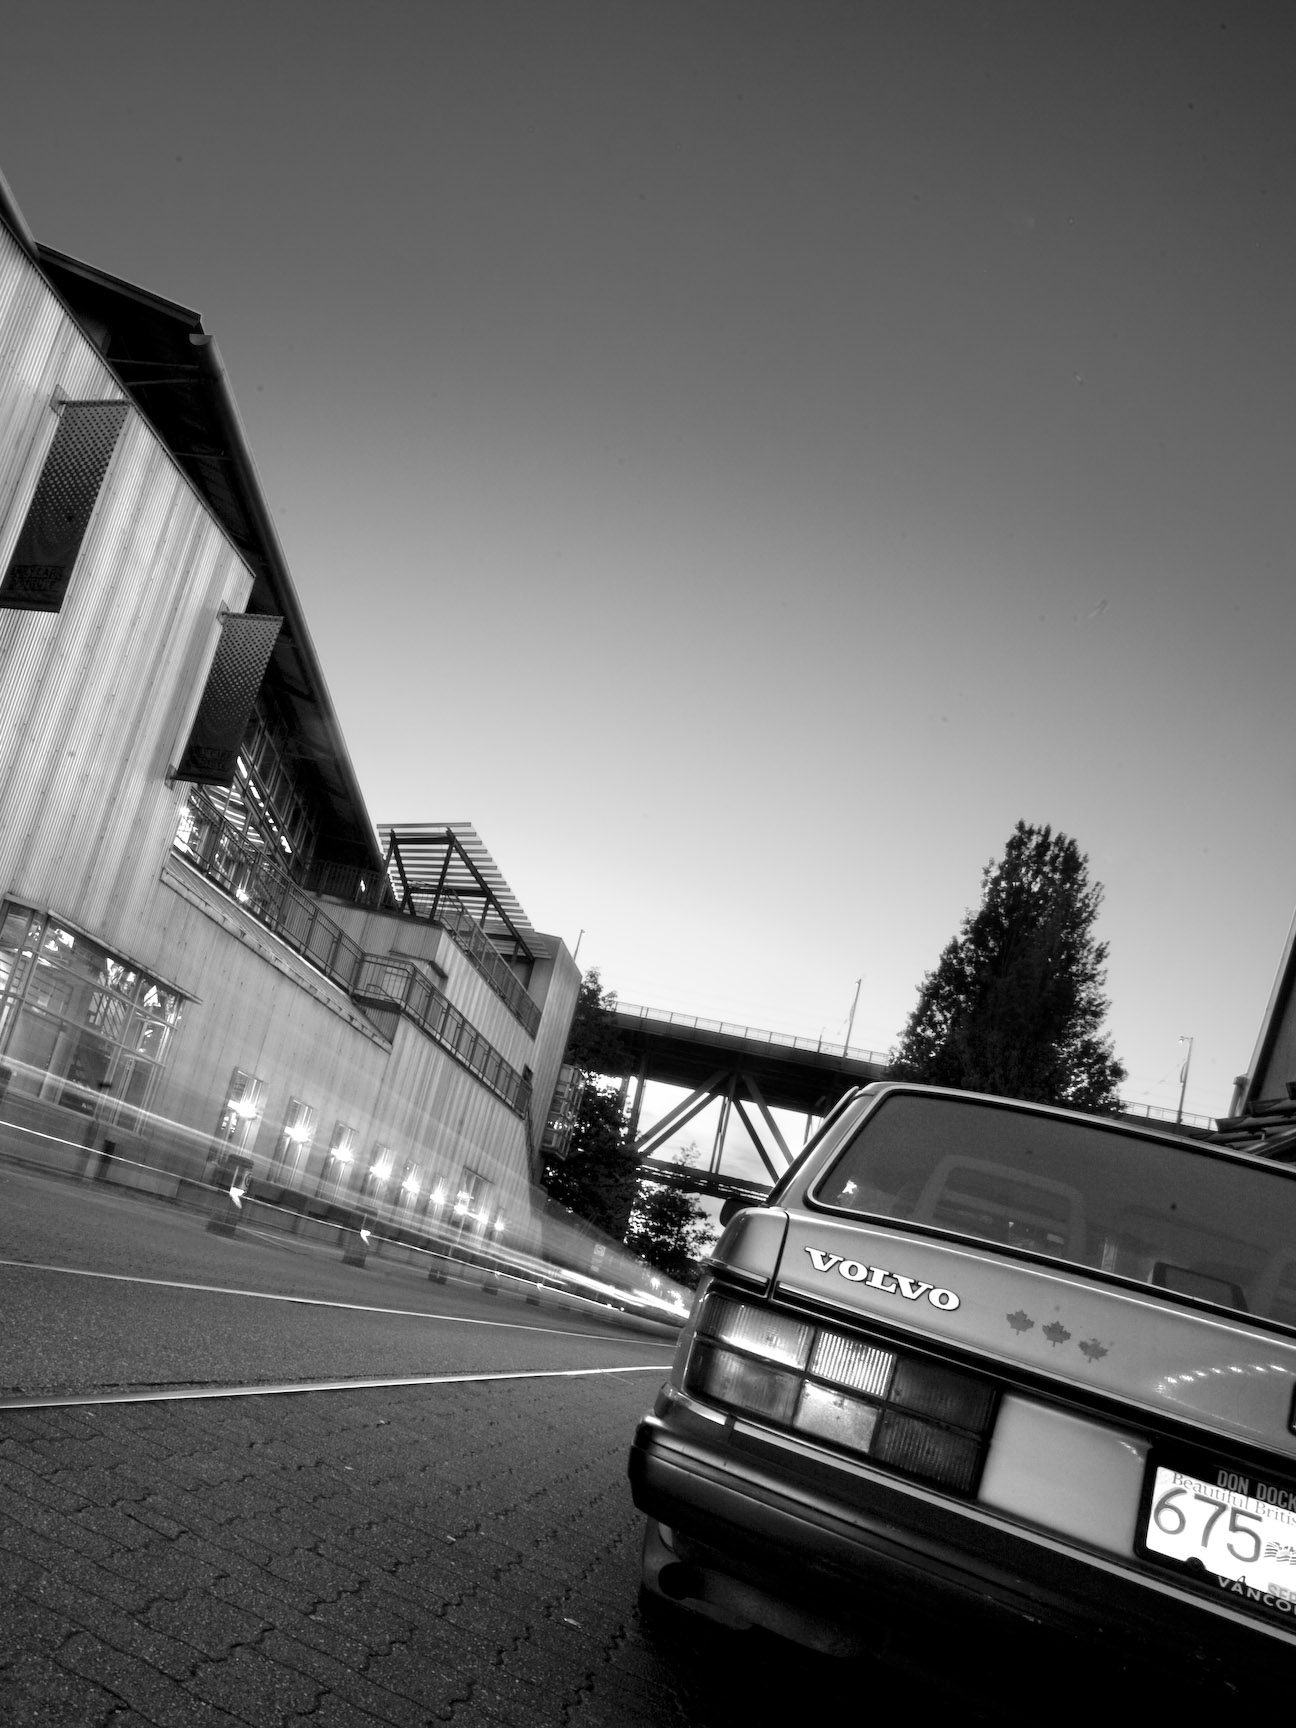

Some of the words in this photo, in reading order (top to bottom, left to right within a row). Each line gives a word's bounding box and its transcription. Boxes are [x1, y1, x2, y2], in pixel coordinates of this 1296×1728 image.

[805, 1247, 961, 1311] VOLVO
[1171, 1471, 1249, 1510] Beautiful
[1217, 1469, 1249, 1494] DON
[1154, 1487, 1263, 1562] 675
[1217, 1575, 1296, 1616] VANCO
